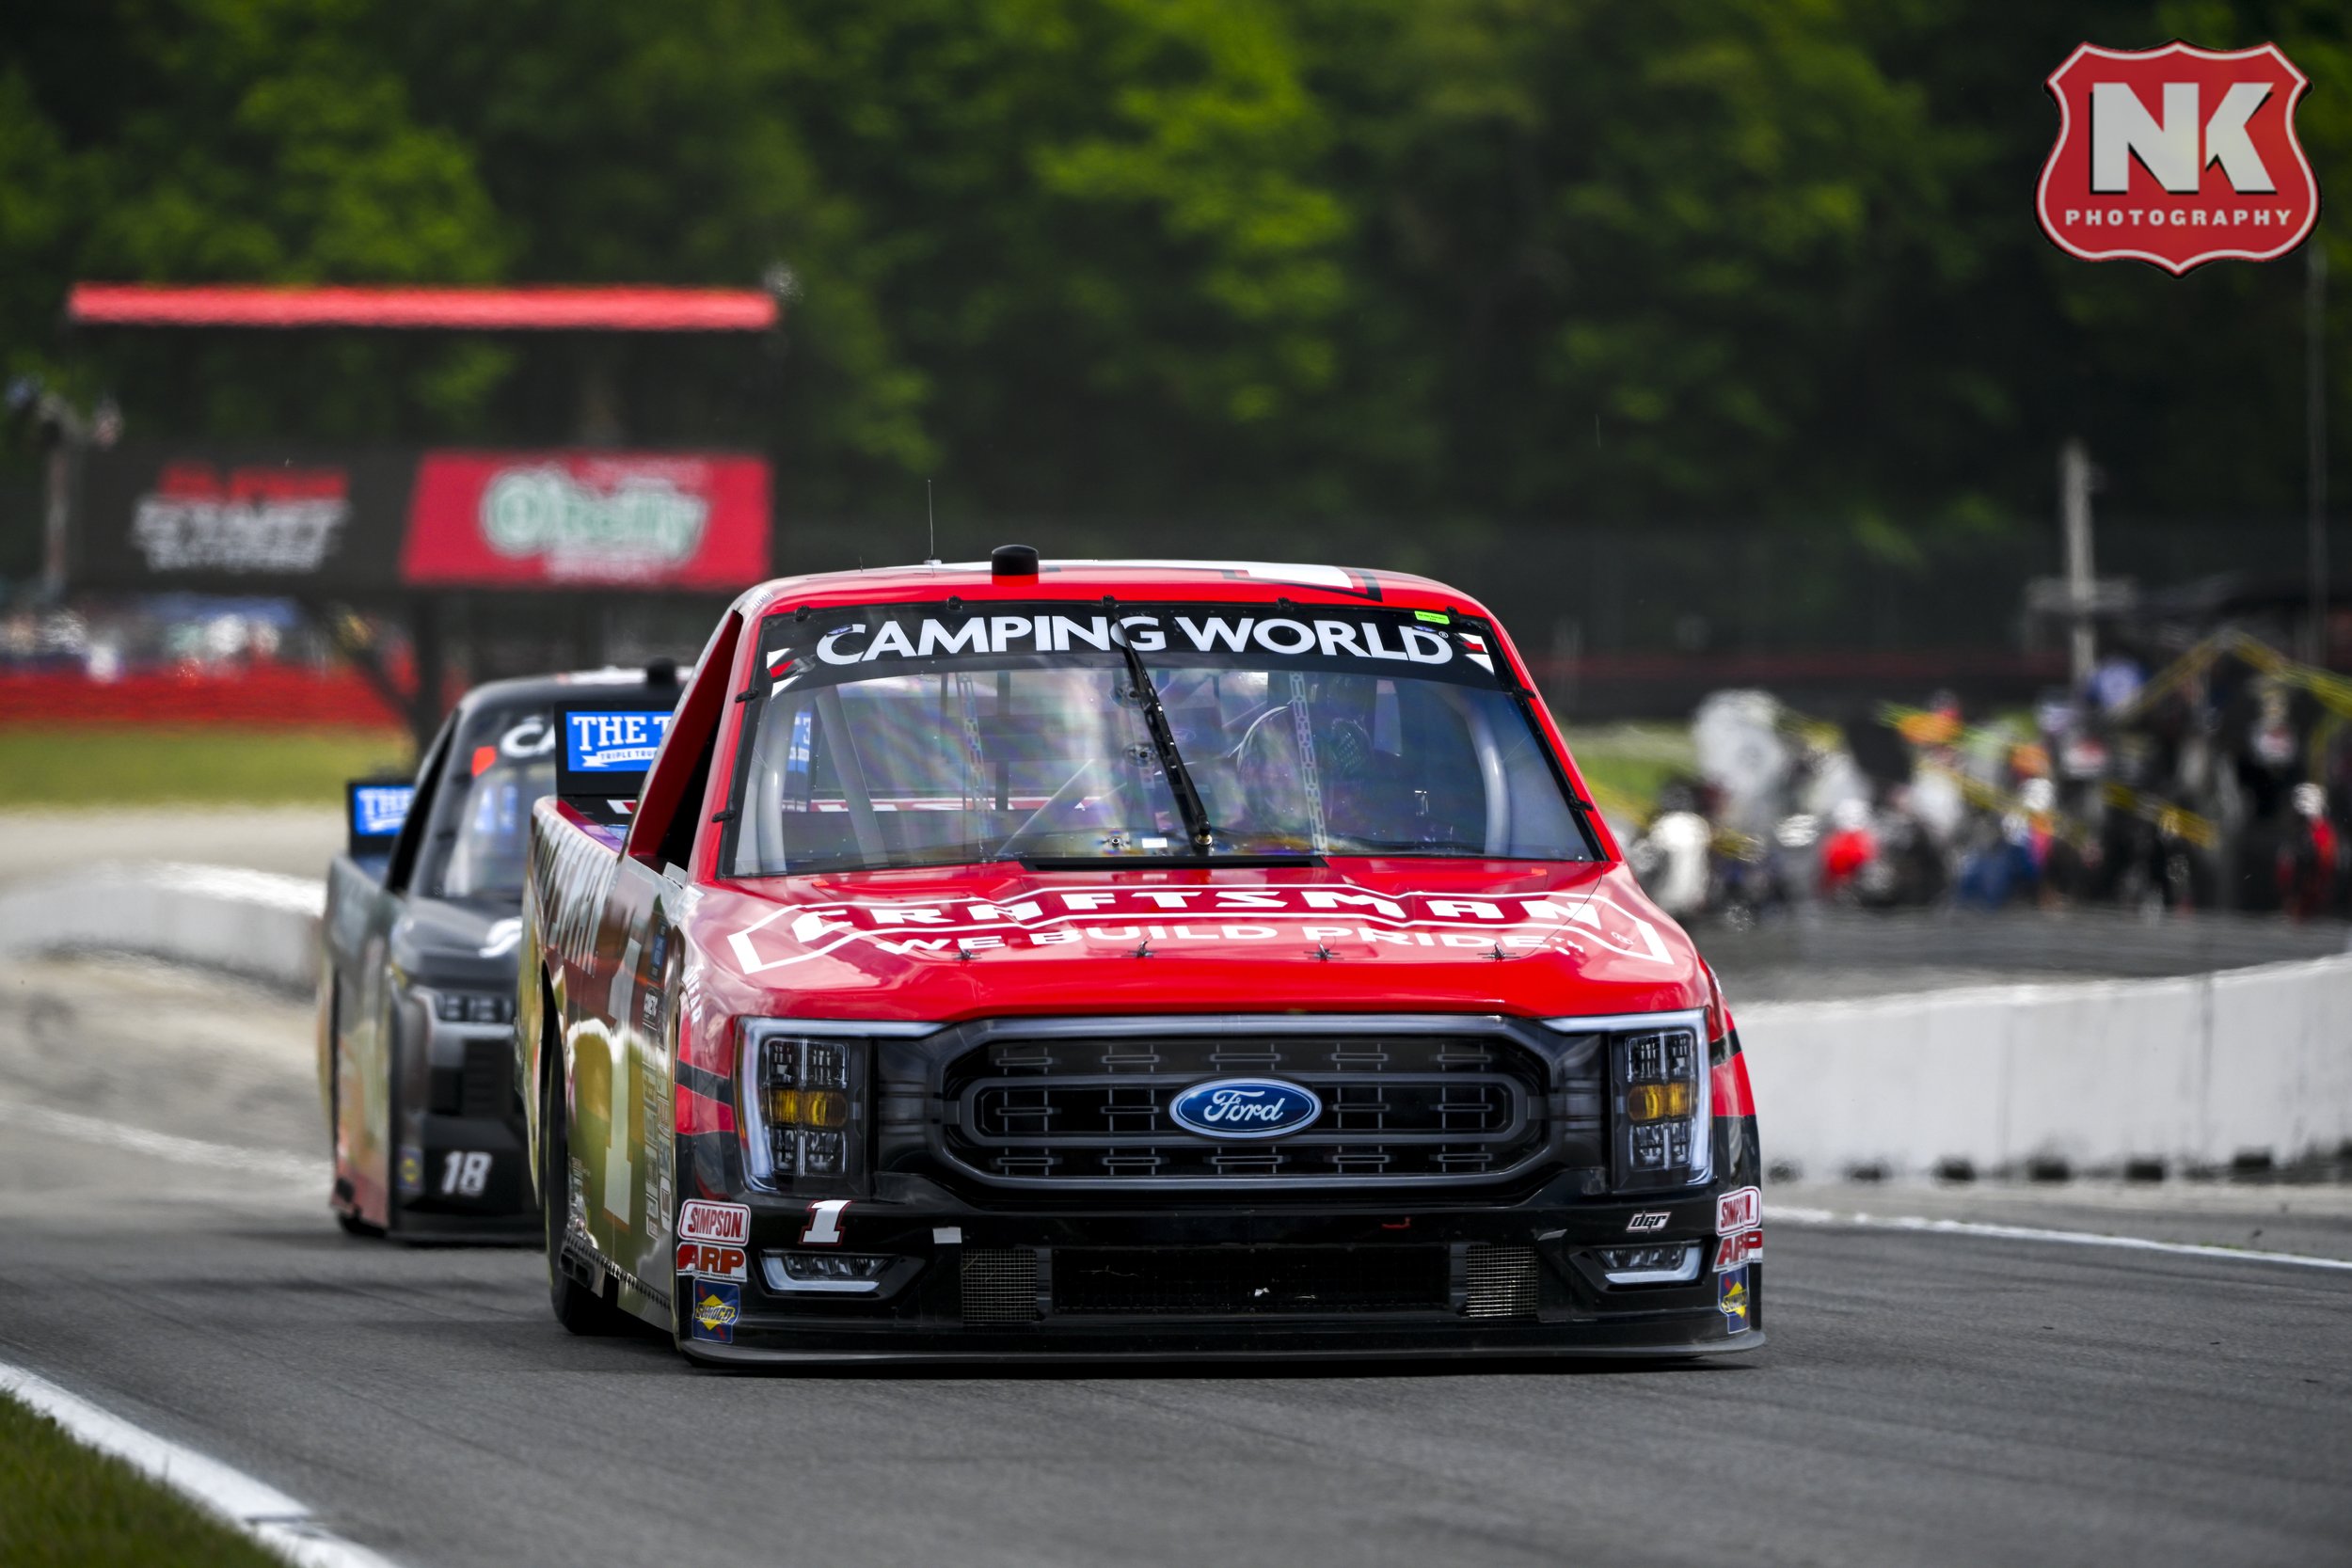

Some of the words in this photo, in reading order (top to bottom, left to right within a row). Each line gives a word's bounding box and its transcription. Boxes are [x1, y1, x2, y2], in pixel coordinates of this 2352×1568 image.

[816, 615, 1167, 666] CAMPING
[1174, 616, 1454, 665] WORLD
[571, 716, 647, 752] THE
[600, 751, 632, 760] TRIPLE
[635, 750, 653, 758] TRU
[790, 891, 1602, 943] CRAFTSMAN
[875, 935, 1007, 956] WE
[1029, 925, 1278, 946] BUILD
[1302, 926, 1551, 949] PRIDE
[1203, 1089, 1286, 1122] Ford
[440, 1150, 493, 1196] 18
[687, 1206, 744, 1239] SIMPSON
[802, 1199, 852, 1243] 1
[676, 1243, 745, 1275] ARP
[1717, 1230, 1763, 1266] ARP
